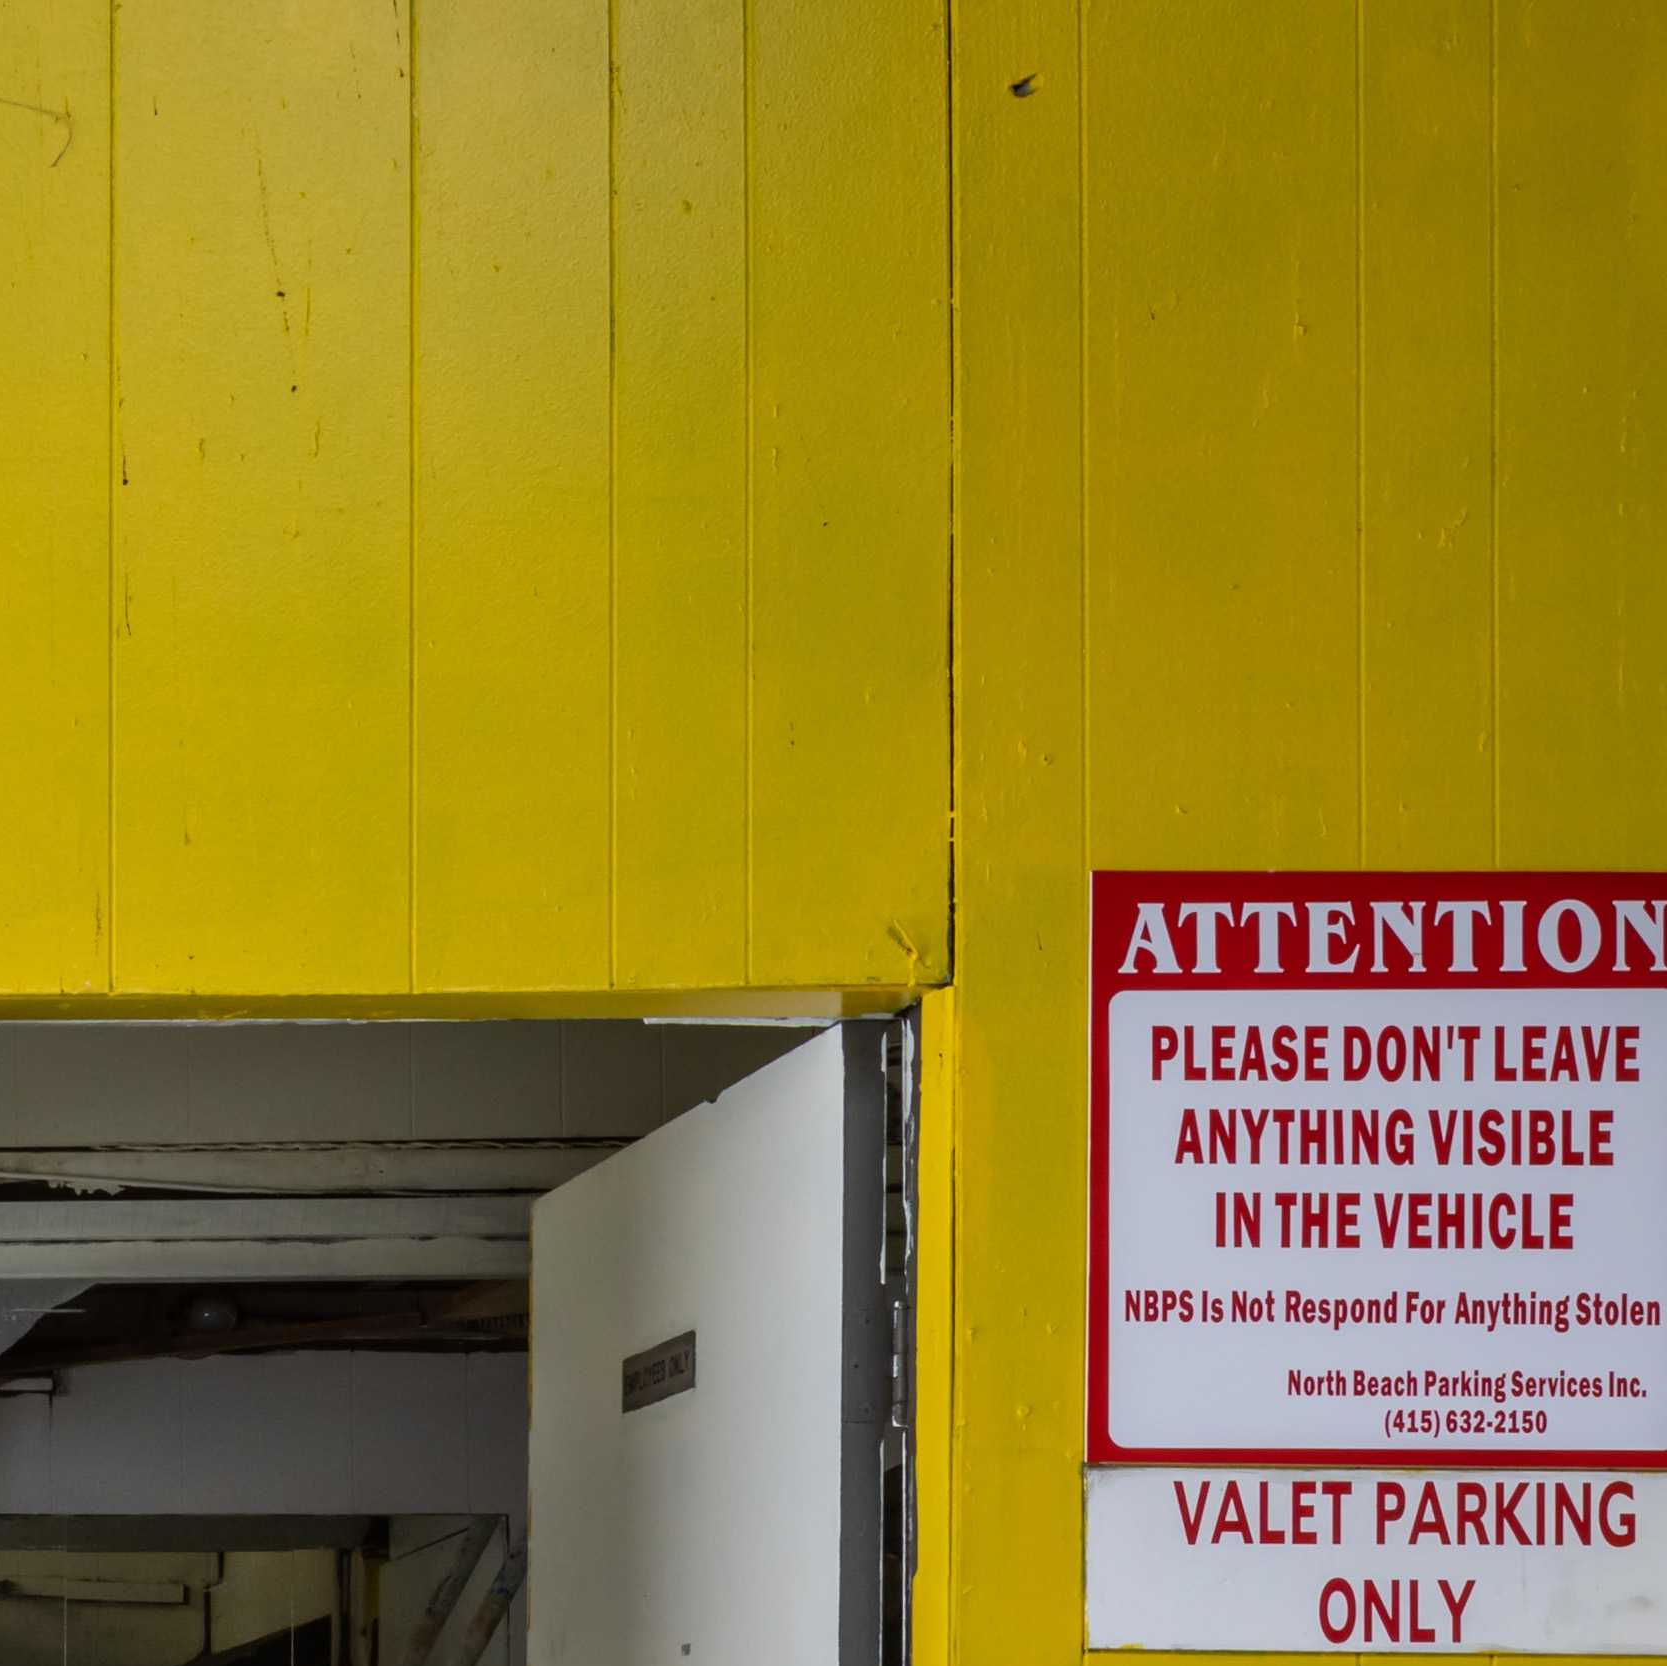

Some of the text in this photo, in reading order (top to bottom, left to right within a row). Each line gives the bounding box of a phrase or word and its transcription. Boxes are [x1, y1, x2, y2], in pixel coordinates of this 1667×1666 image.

[1118, 899, 1667, 973] ATTENTION
[1152, 1025, 1640, 1082] PLEASE DON'T LEAVE
[1175, 1109, 1614, 1166] ANYTHING VISIBLE
[1216, 1192, 1573, 1249] IN THE VEHICLE
[1125, 1290, 1660, 1333] NBPS Is Not Respond For Anything Stolen
[1288, 1370, 1646, 1403] North Beach Parking Services Inc.
[1385, 1410, 1547, 1438] (415) 632-2150
[1174, 1480, 1635, 1547] VALET PARKING
[1319, 1578, 1475, 1644] ONLY
